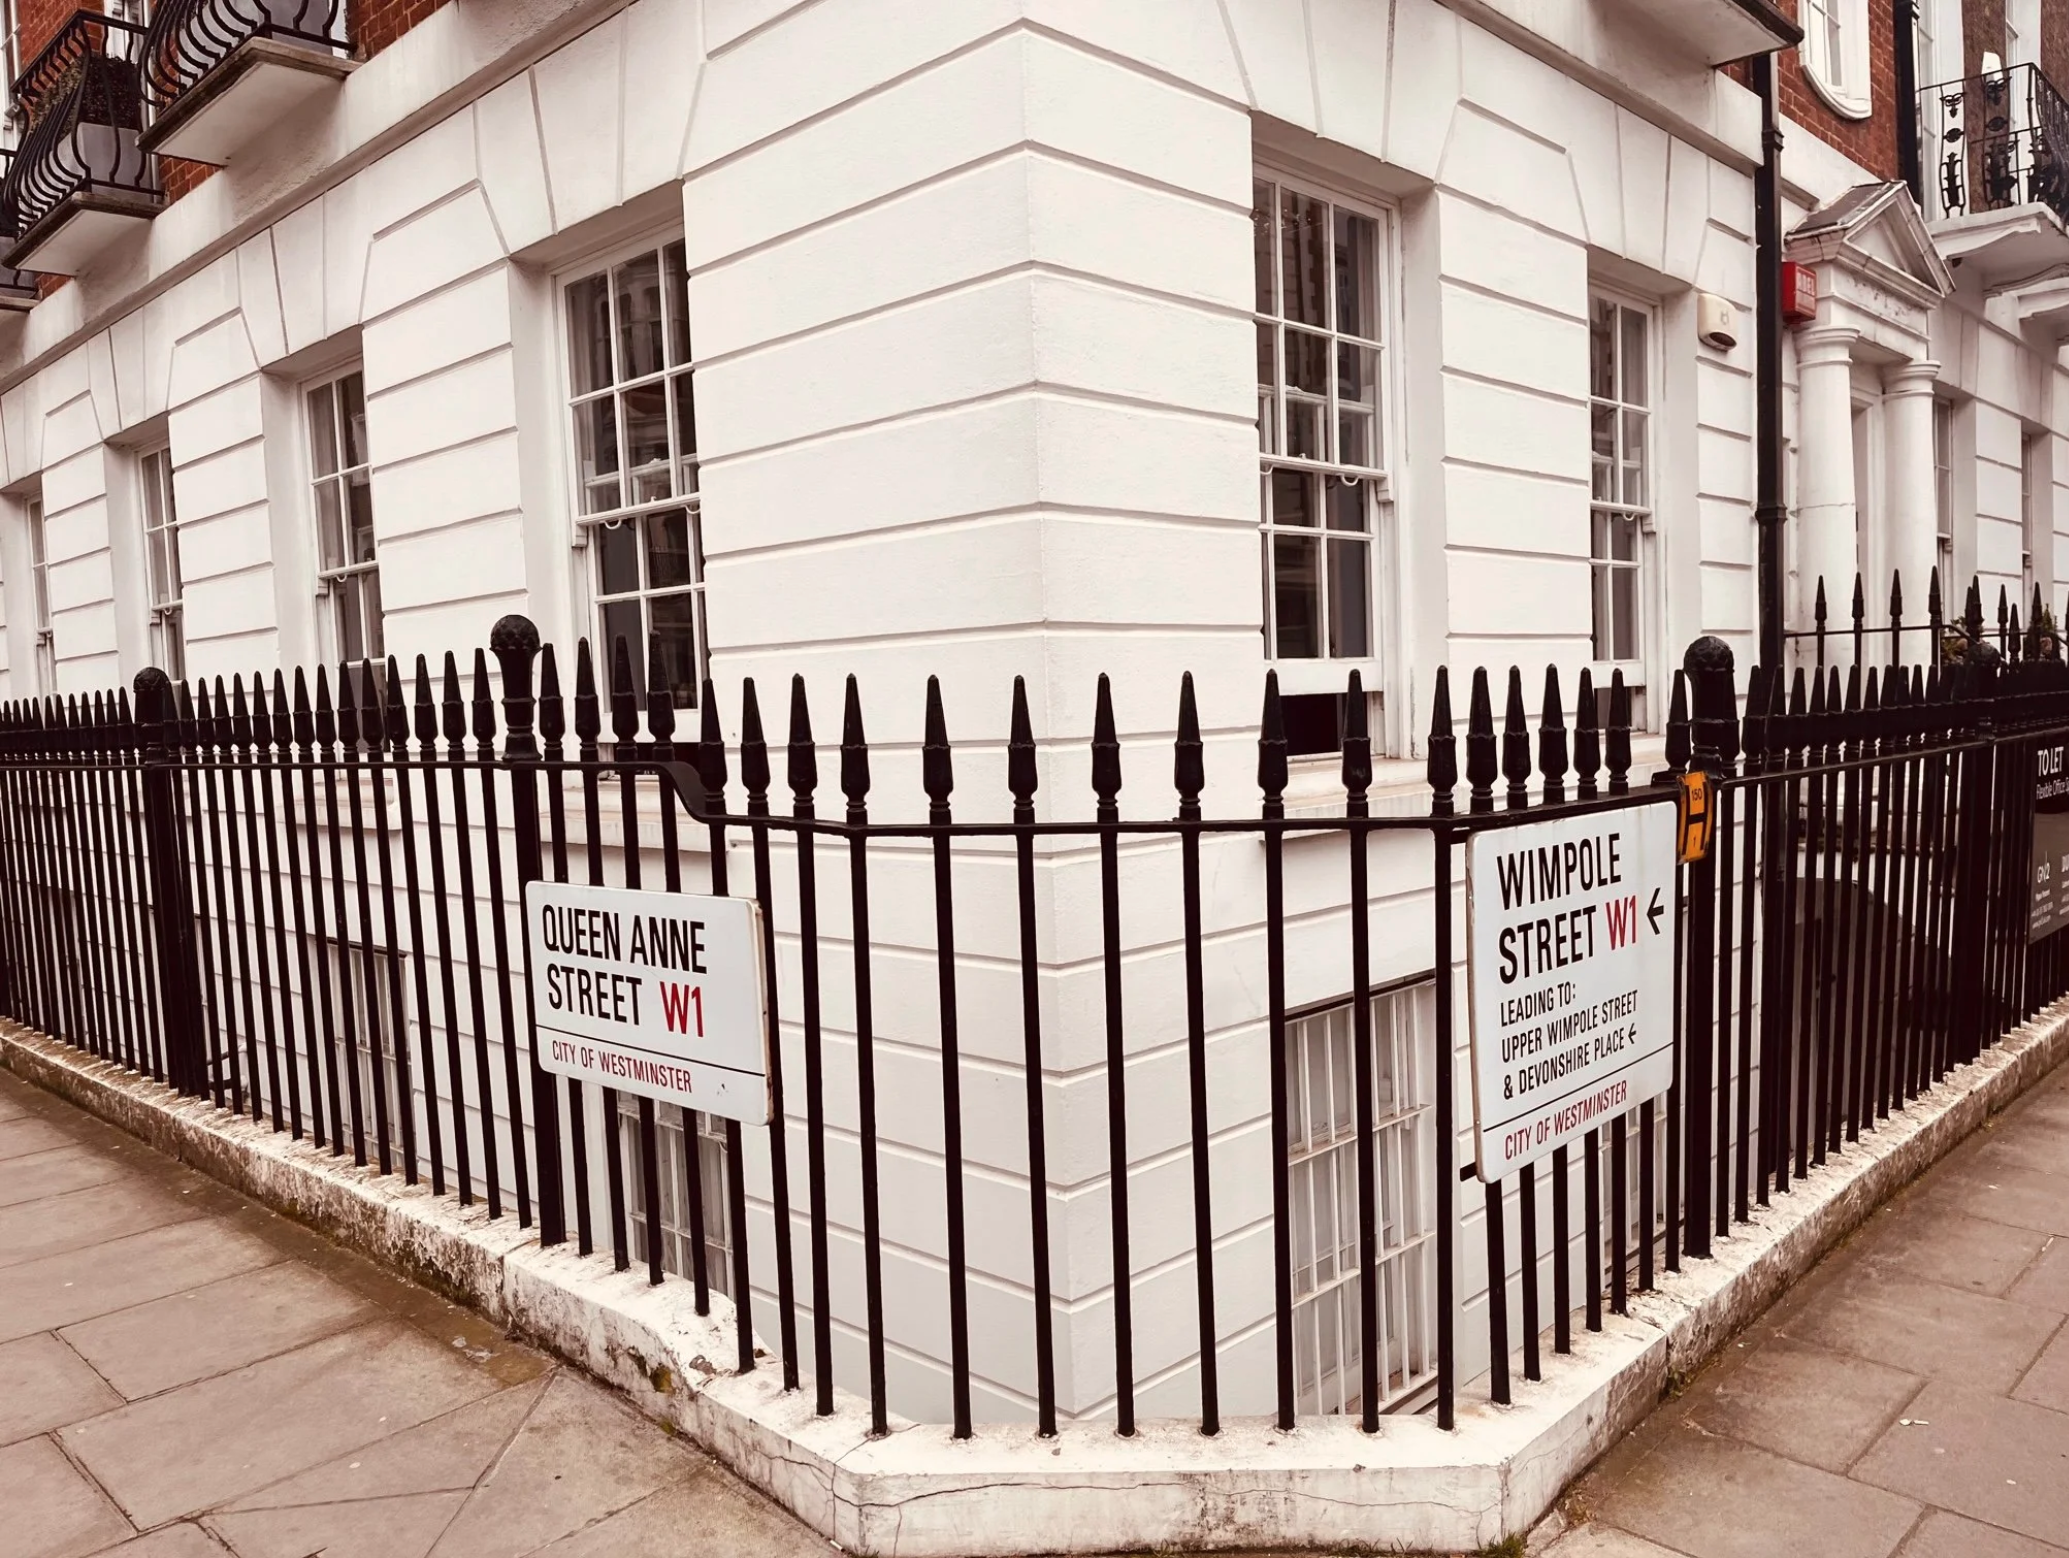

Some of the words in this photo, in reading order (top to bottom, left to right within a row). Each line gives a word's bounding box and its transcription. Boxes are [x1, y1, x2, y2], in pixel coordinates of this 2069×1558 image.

[1691, 788, 1703, 802] 150
[2037, 748, 2050, 777] TO
[2050, 745, 2064, 774] LET
[1496, 832, 1622, 911] WIMPOLE
[542, 904, 622, 962] QUEEN
[629, 914, 708, 975] ANNE
[1498, 904, 1597, 985] STREET
[1605, 894, 1637, 951] W1
[546, 963, 643, 1026] STREET
[659, 980, 704, 1038] W1
[1500, 987, 1554, 1028] LEADING
[1557, 981, 1576, 1008] TO:
[1502, 1026, 1542, 1064] UPPER
[1547, 1005, 1598, 1047] WIMPOLE
[1601, 989, 1638, 1025] STREET
[552, 1039, 576, 1066] CITY
[580, 1046, 595, 1070] OF
[598, 1050, 693, 1094] WESTMINSTER
[1503, 1074, 1514, 1100] &
[1518, 1042, 1590, 1095] DEVONSHIRE
[1594, 1027, 1625, 1062] PLACE
[1505, 1125, 1532, 1161] CITY
[1536, 1116, 1550, 1145] OF
[1554, 1079, 1628, 1136] WESTMINSTER
